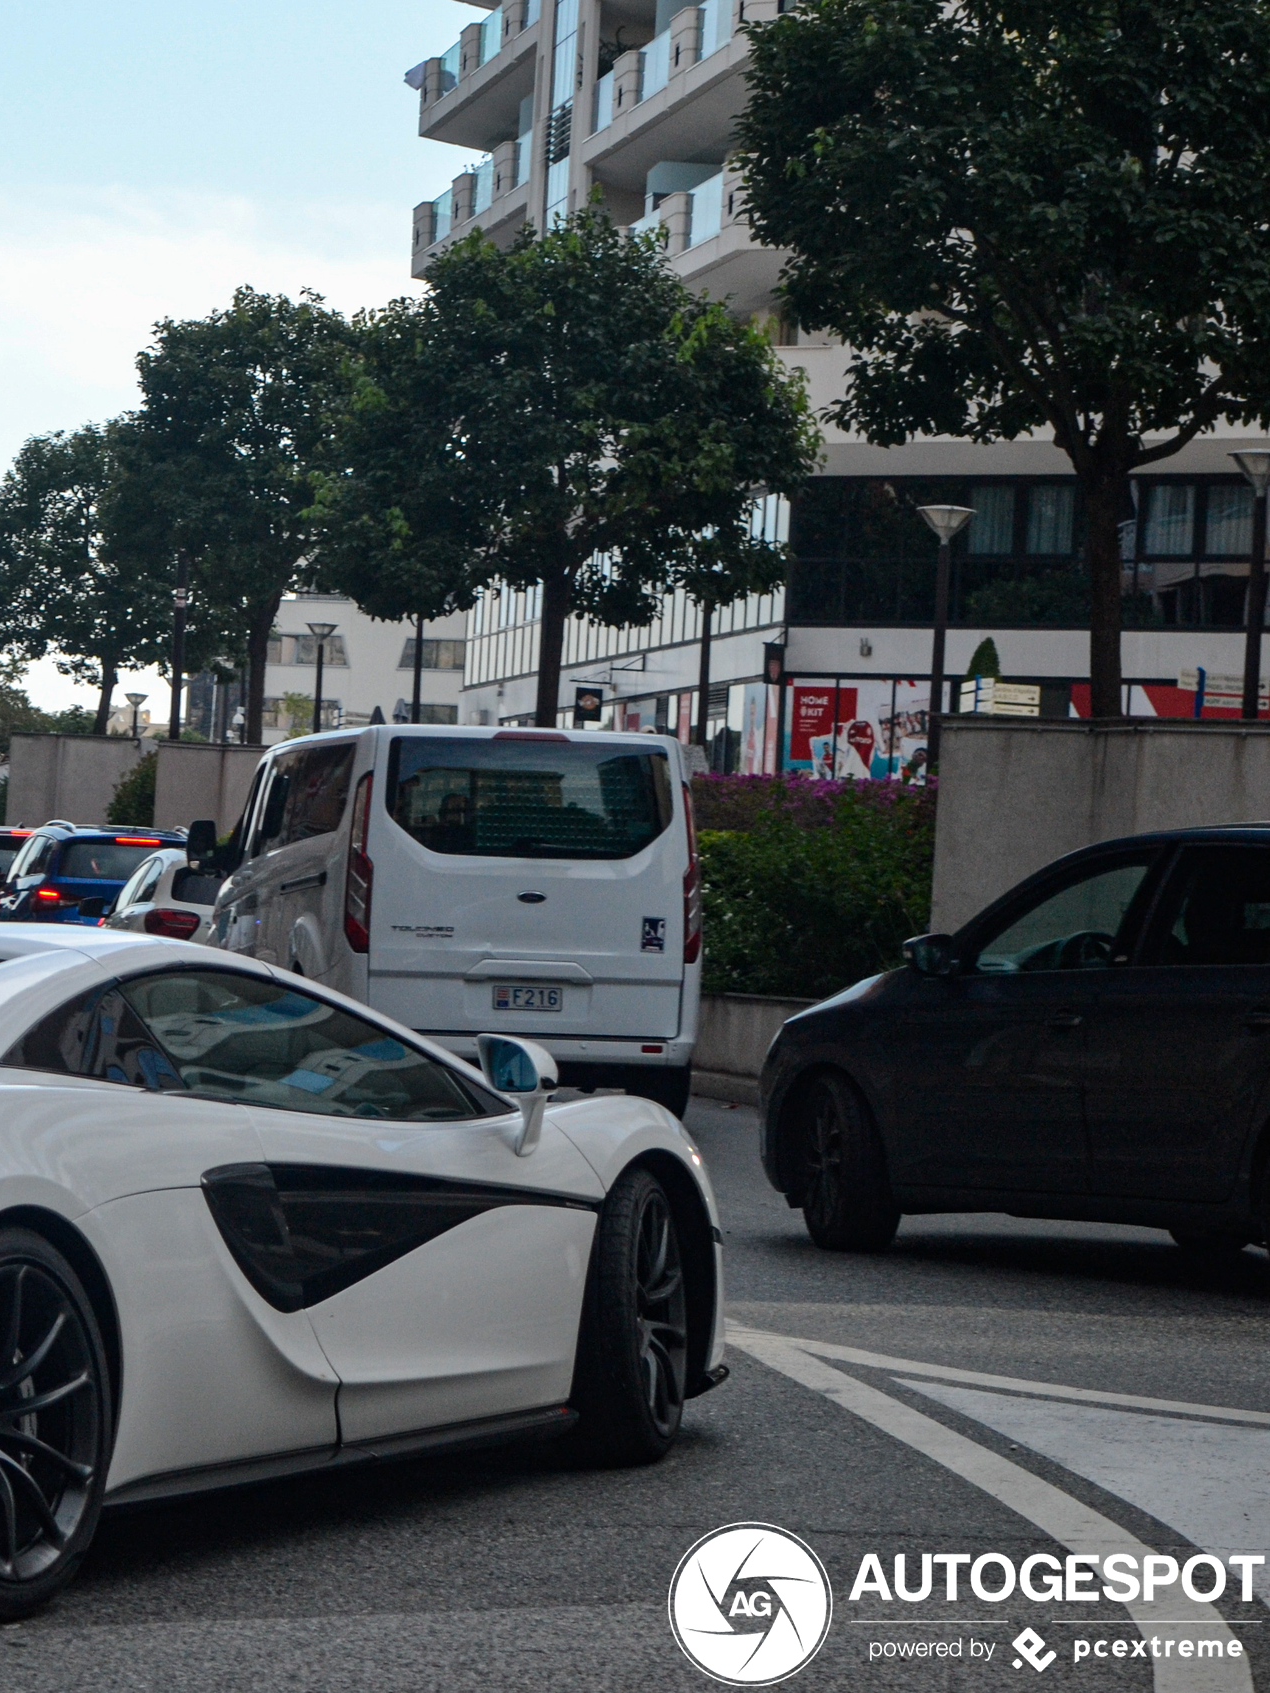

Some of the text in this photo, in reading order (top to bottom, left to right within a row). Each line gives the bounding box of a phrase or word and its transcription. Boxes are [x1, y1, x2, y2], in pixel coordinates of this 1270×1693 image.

[799, 695, 829, 705] HOME
[807, 707, 824, 717] KIT
[513, 988, 558, 1006] F216
